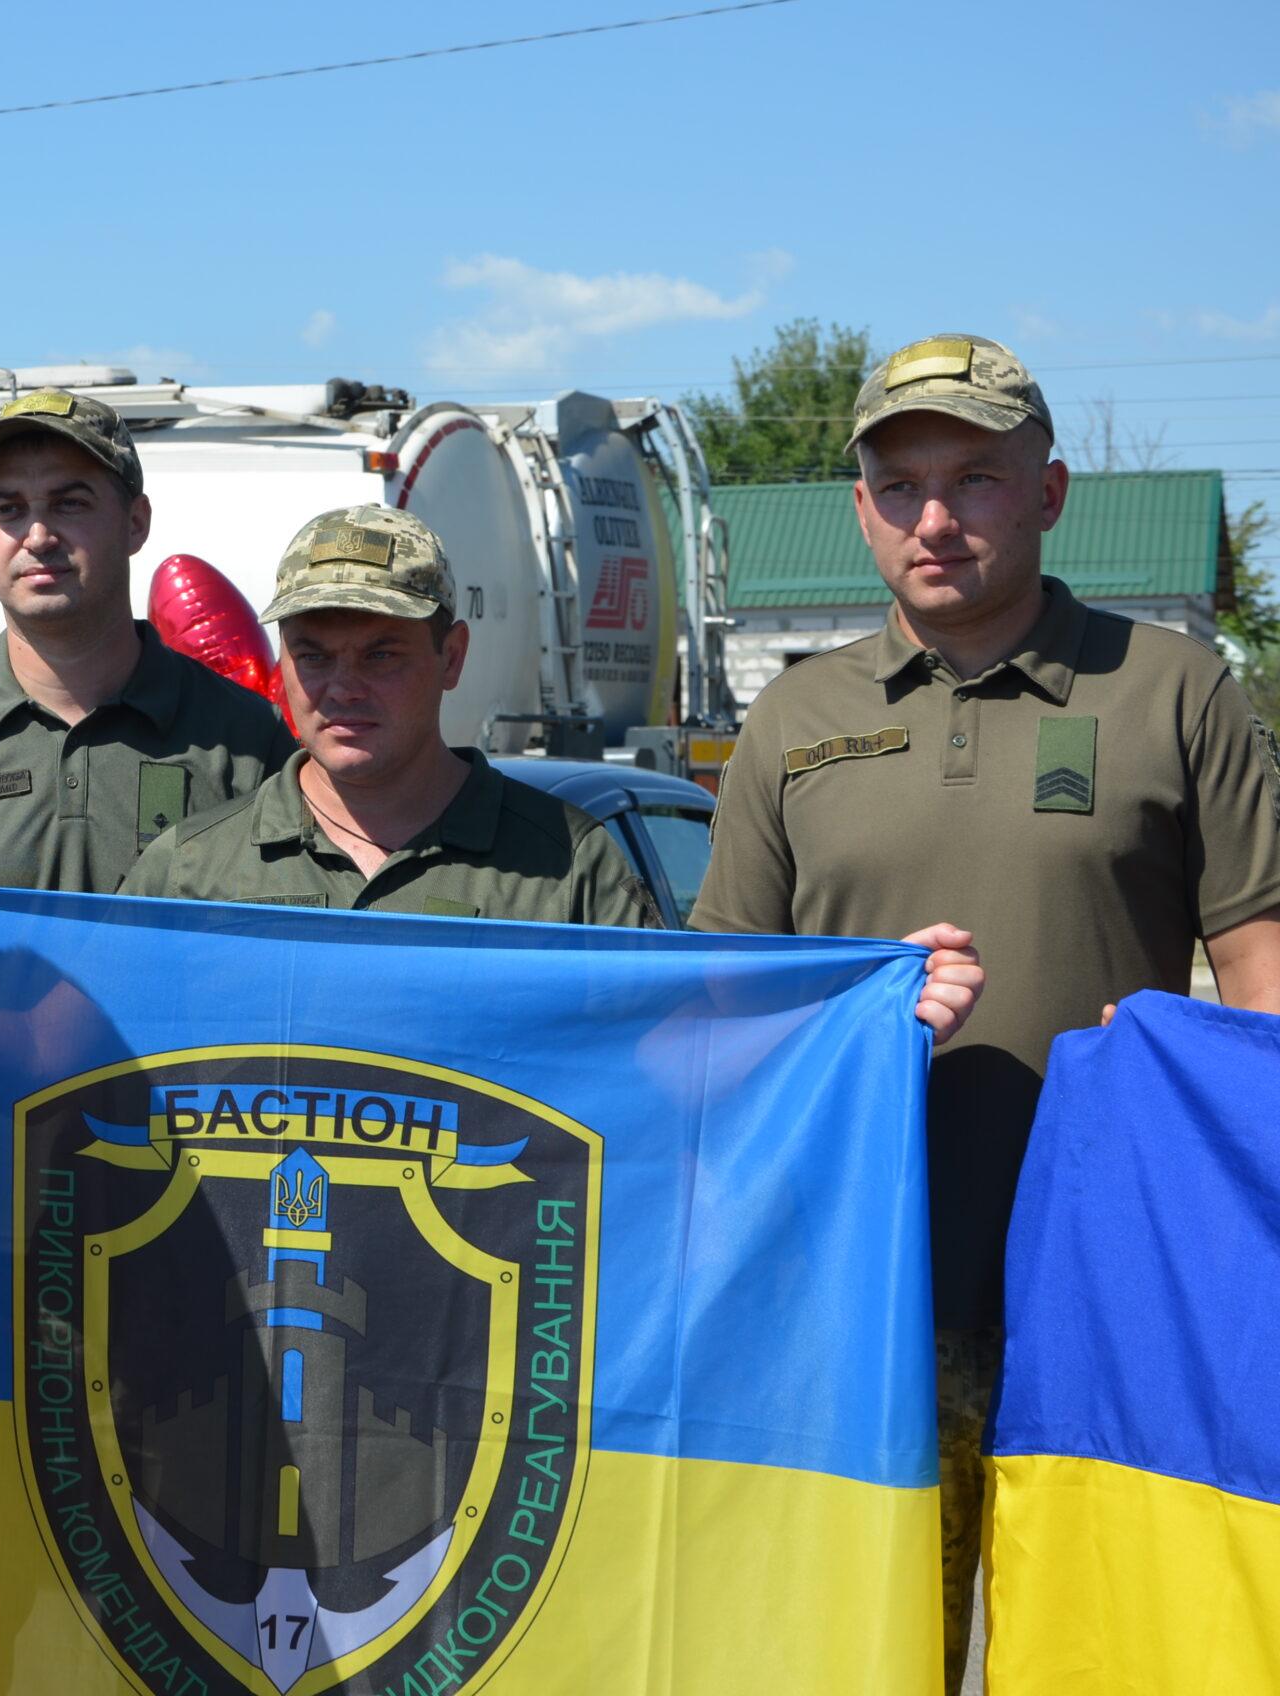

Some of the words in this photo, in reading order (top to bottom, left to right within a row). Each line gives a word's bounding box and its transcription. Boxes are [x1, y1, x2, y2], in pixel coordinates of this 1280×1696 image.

[467, 586, 483, 619] 70
[164, 1088, 443, 1151] БАСТІОН
[30, 1168, 82, 1494] ПРИКОРДОННА
[57, 1502, 209, 1696] КОМЕНДАТ
[380, 1553, 531, 1696] ИДКОГО
[508, 1199, 577, 1546] РЕАГУВАННЯ
[260, 1614, 310, 1650] 17
